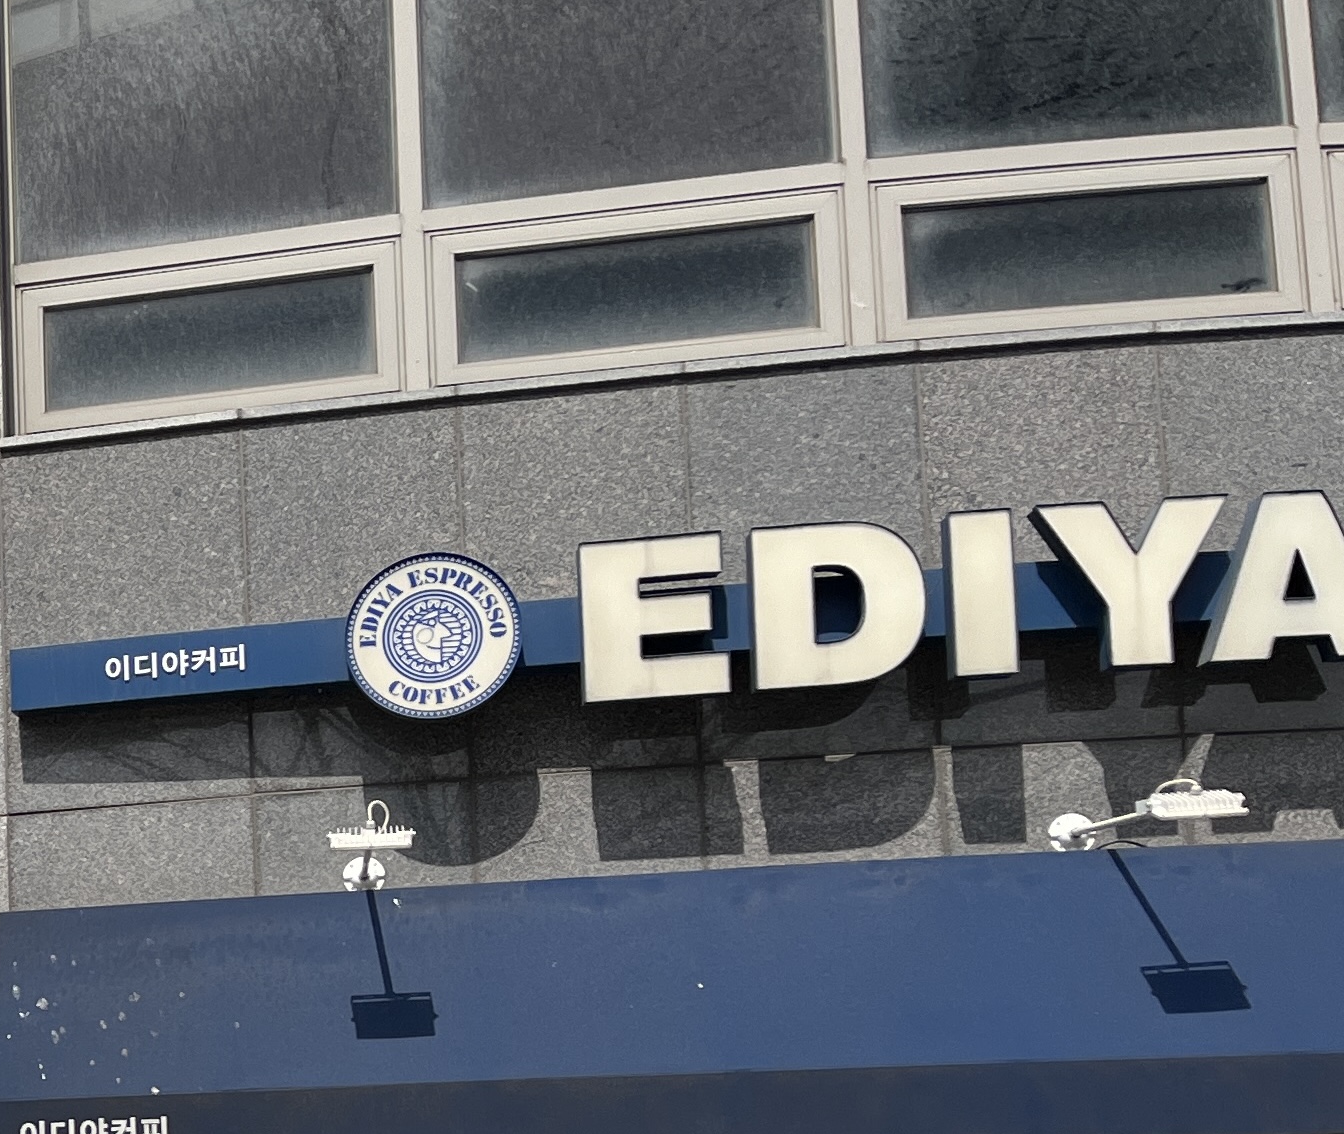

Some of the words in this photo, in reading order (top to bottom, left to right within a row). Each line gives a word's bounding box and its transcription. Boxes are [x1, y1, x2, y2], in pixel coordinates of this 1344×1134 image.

[360, 582, 404, 649] EDIYA
[407, 566, 509, 640] ESPRESSO
[577, 488, 1344, 706] EDIYA
[104, 643, 247, 682] 이디야커피
[388, 673, 481, 706] COFFEE
